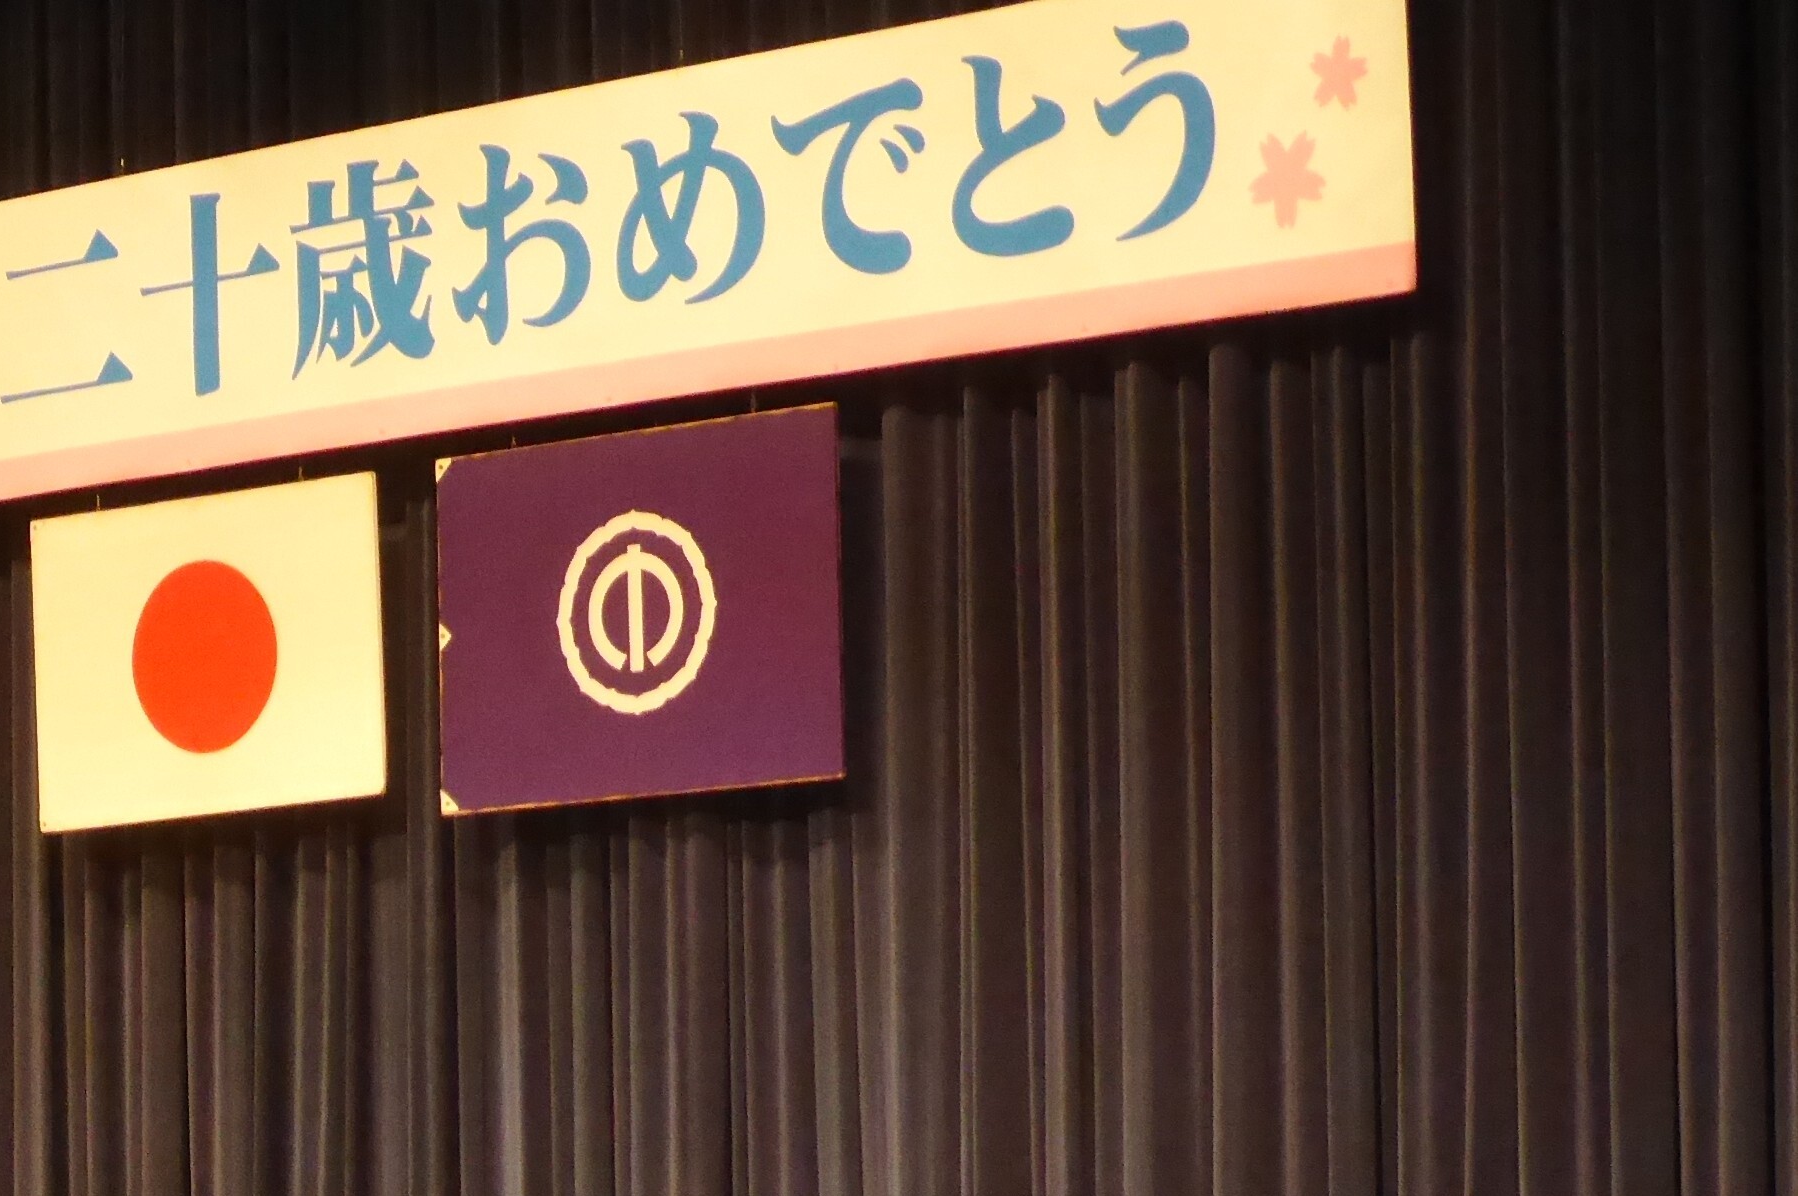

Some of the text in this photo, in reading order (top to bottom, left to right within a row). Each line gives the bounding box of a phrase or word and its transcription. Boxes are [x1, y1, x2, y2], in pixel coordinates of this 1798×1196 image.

[0, 19, 1216, 405] 二十歳おめでとう
